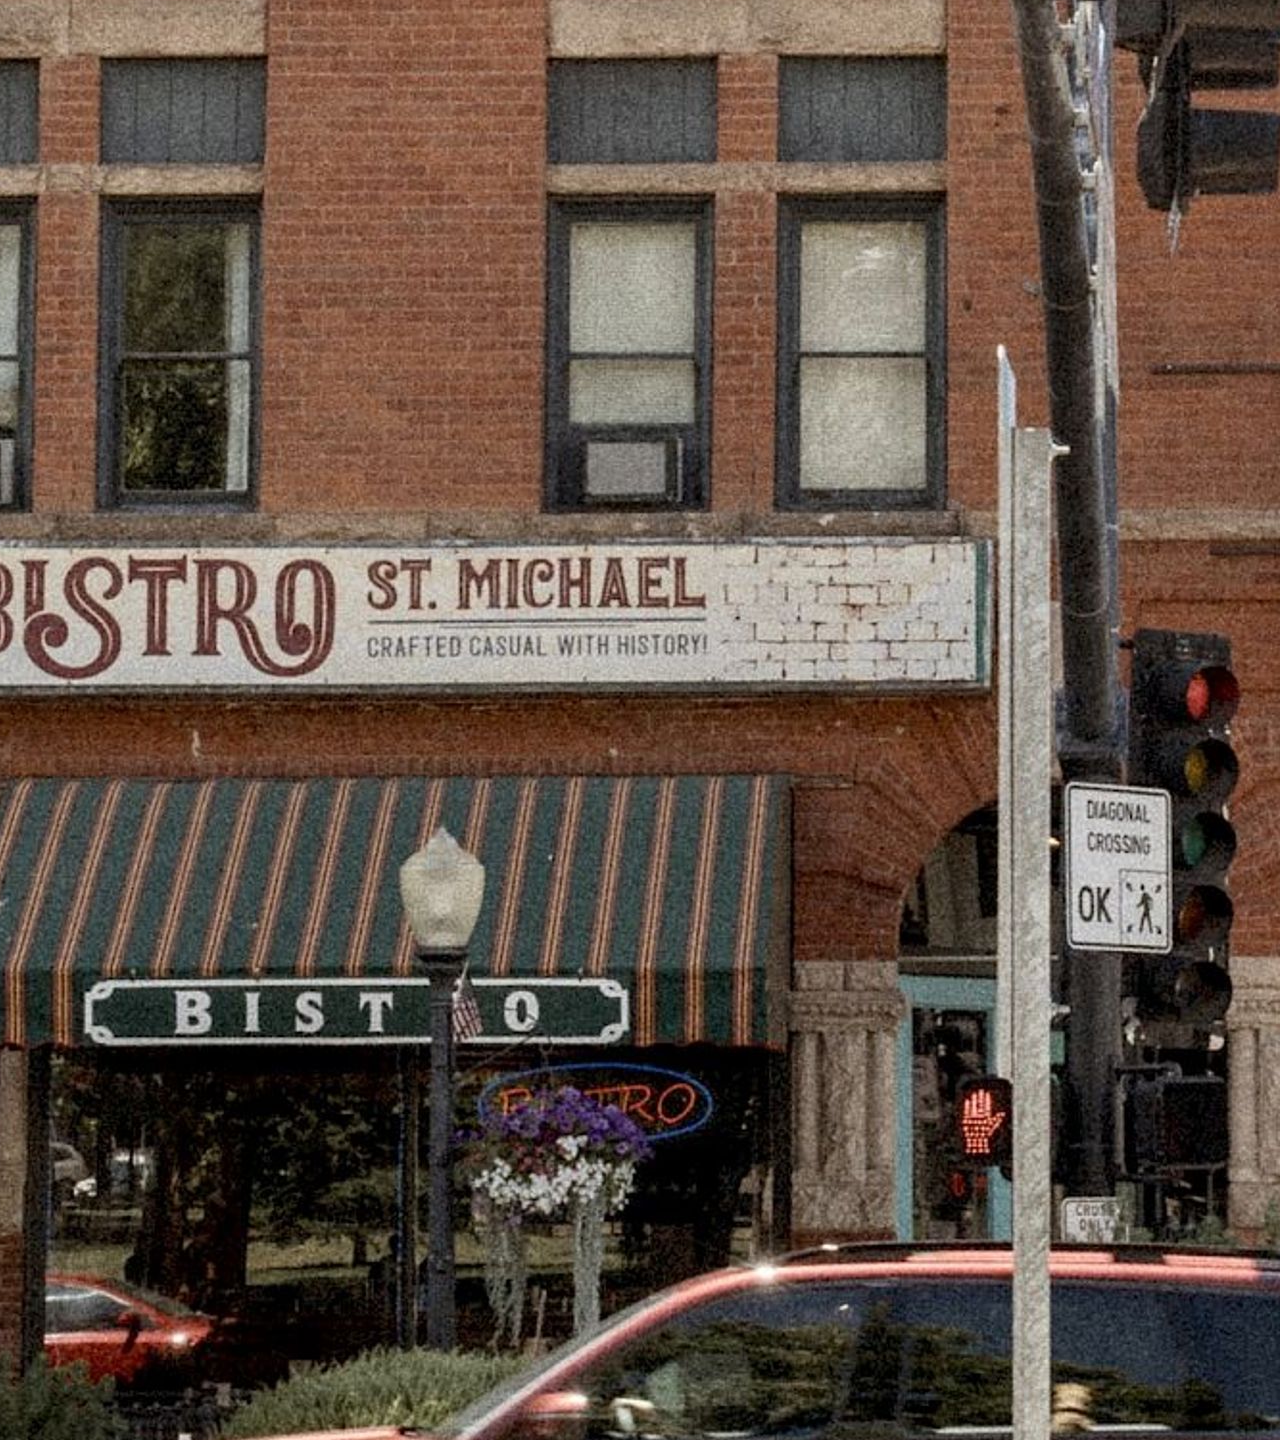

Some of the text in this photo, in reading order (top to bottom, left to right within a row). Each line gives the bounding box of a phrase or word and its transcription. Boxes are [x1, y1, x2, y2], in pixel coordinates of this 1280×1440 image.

[367, 555, 707, 611] ST. MICHAEL
[367, 634, 708, 658] CRAFTED CASUAL WITH HISTORY!
[1086, 800, 1151, 823] DIAGONAL
[1087, 831, 1151, 855] CROSSING
[1078, 885, 1112, 923] OK
[174, 990, 540, 1035] BISTO
[498, 1083, 696, 1124] BTRO
